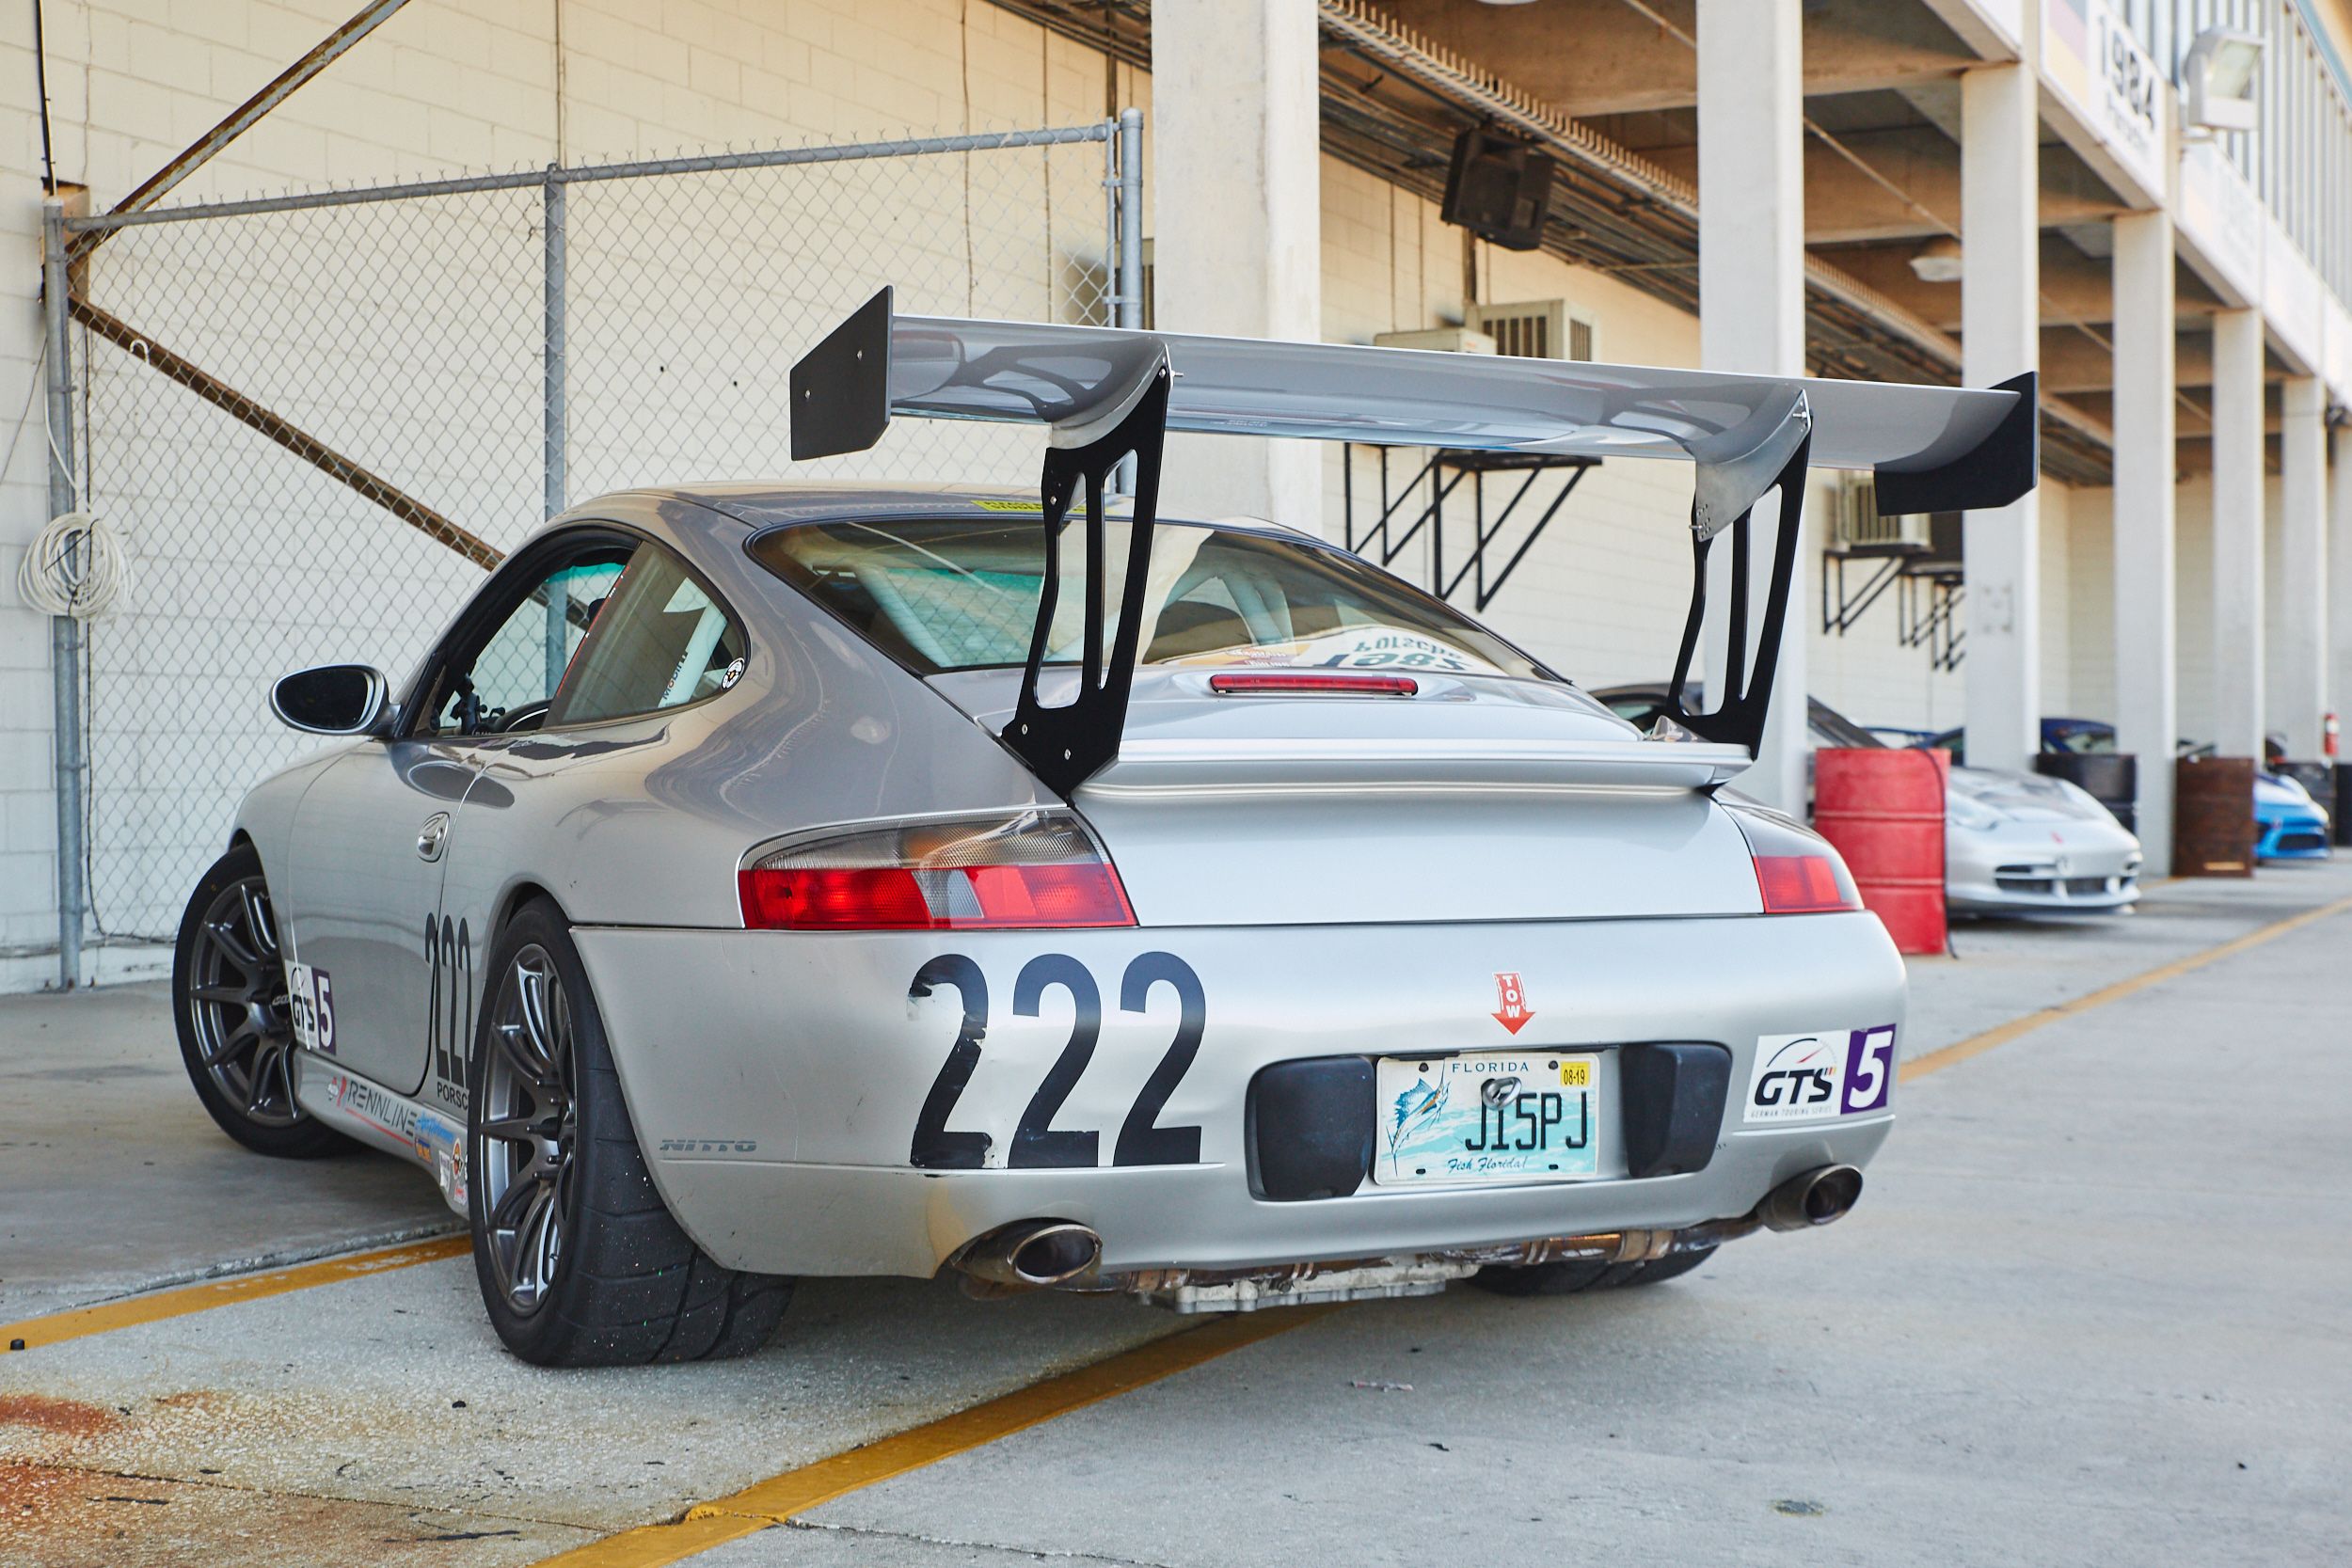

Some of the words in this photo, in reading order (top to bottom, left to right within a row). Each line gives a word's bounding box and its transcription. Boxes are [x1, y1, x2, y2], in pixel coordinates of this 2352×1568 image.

[317, 975, 333, 1048] 5
[424, 911, 472, 1089] 222
[1502, 974, 1521, 1019] TOW
[907, 951, 1206, 1169] 222
[1452, 1062, 1530, 1073] FLORIDA
[1563, 1069, 1585, 1085] 08-19
[1848, 1030, 1894, 1109] 5
[437, 1081, 469, 1112] PORSC
[1754, 1068, 1833, 1106] GTS
[347, 1079, 418, 1137] RENNLINE
[660, 1139, 757, 1152] NITTO
[1447, 1157, 1473, 1174] Fish
